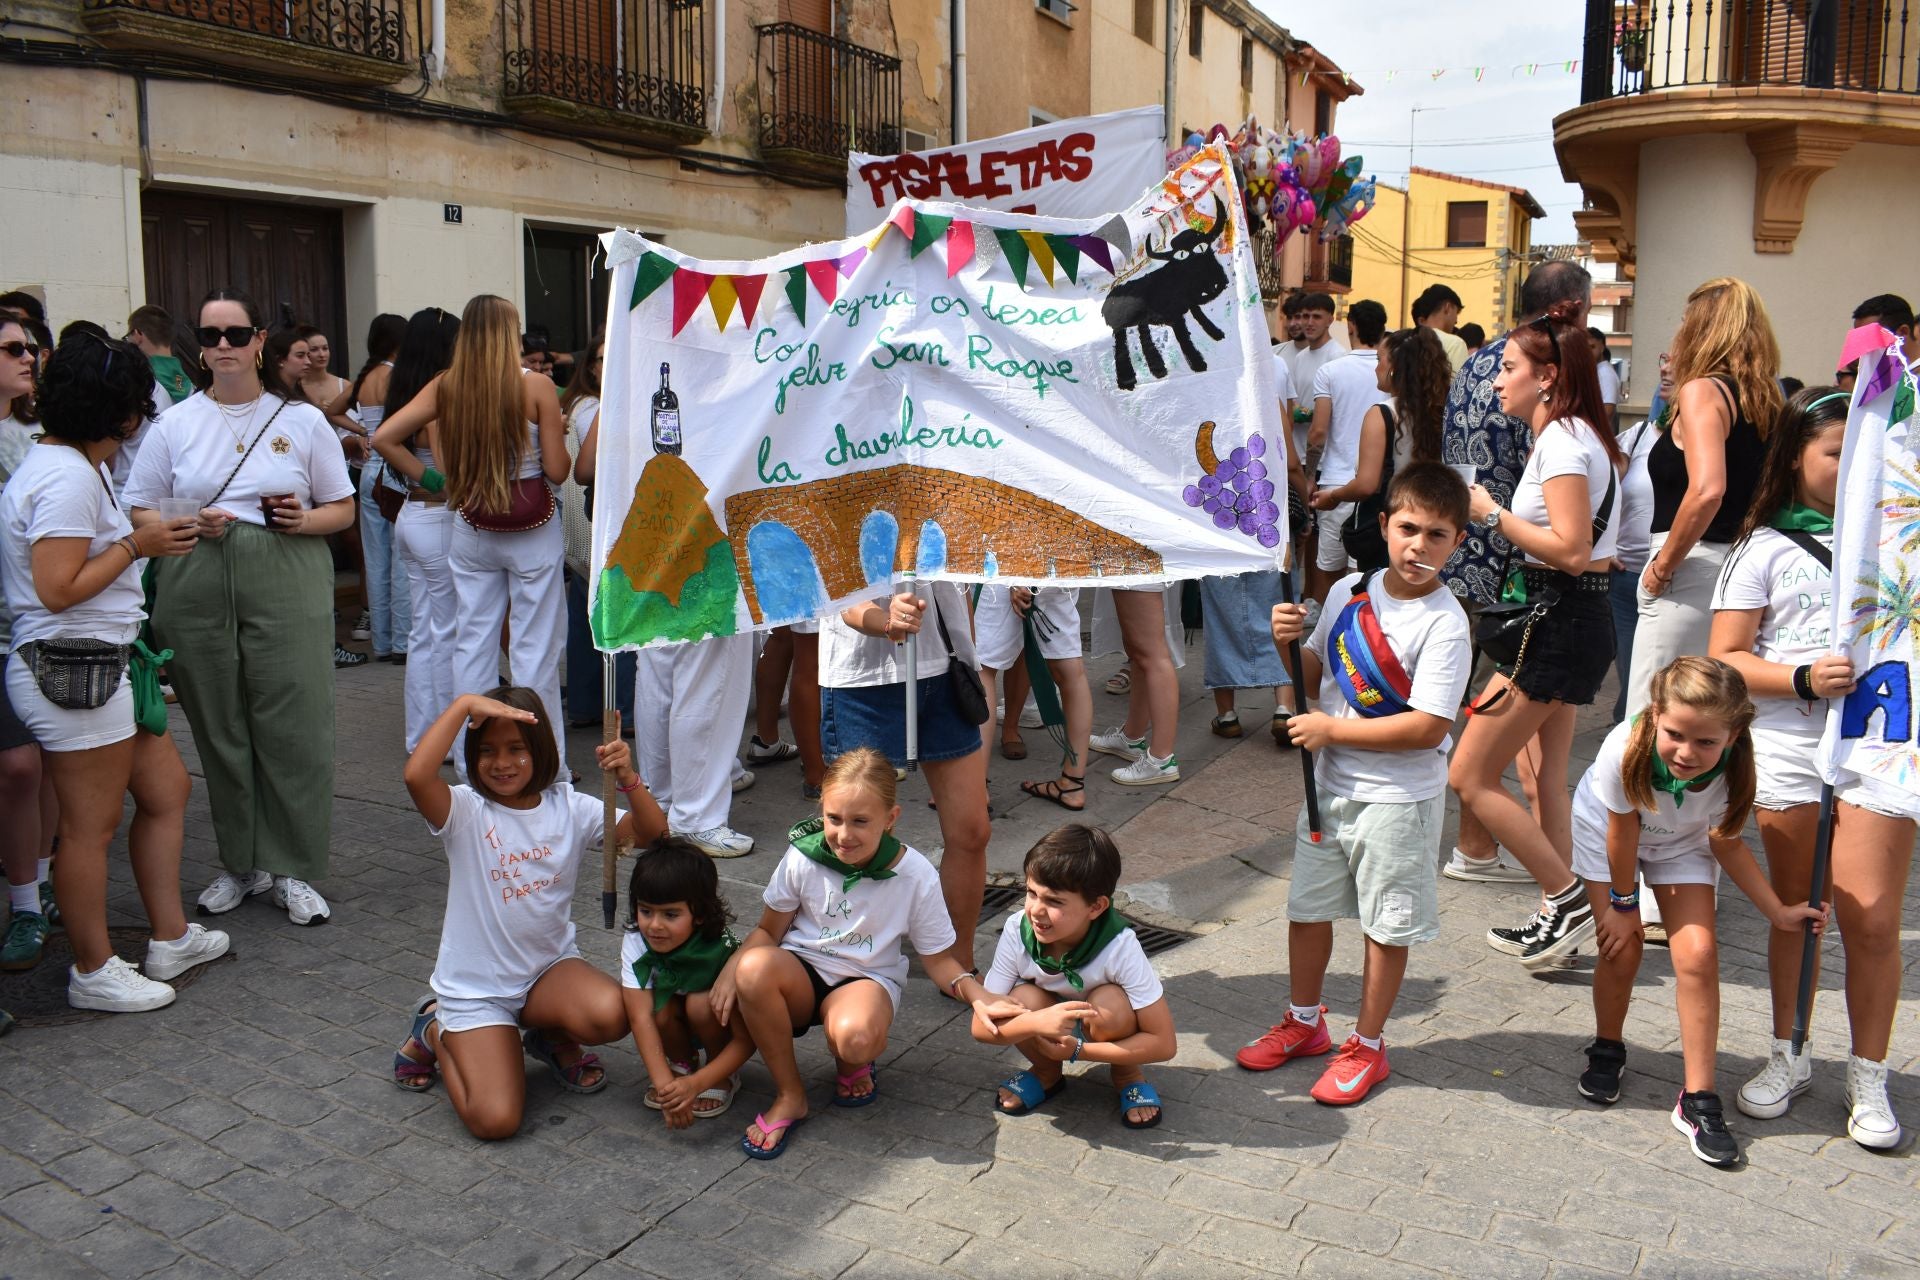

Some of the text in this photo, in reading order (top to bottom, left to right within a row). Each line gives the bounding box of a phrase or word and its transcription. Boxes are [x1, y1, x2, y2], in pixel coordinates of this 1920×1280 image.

[448, 206, 460, 221] 12
[755, 280, 1088, 364] Co egría os desea
[871, 326, 950, 370] San
[968, 334, 1079, 400] Roque
[757, 436, 801, 484] la
[1781, 565, 1831, 589] BAN
[490, 866, 522, 882] DEL
[502, 871, 562, 905] PARQUE
[825, 891, 852, 920] LA
